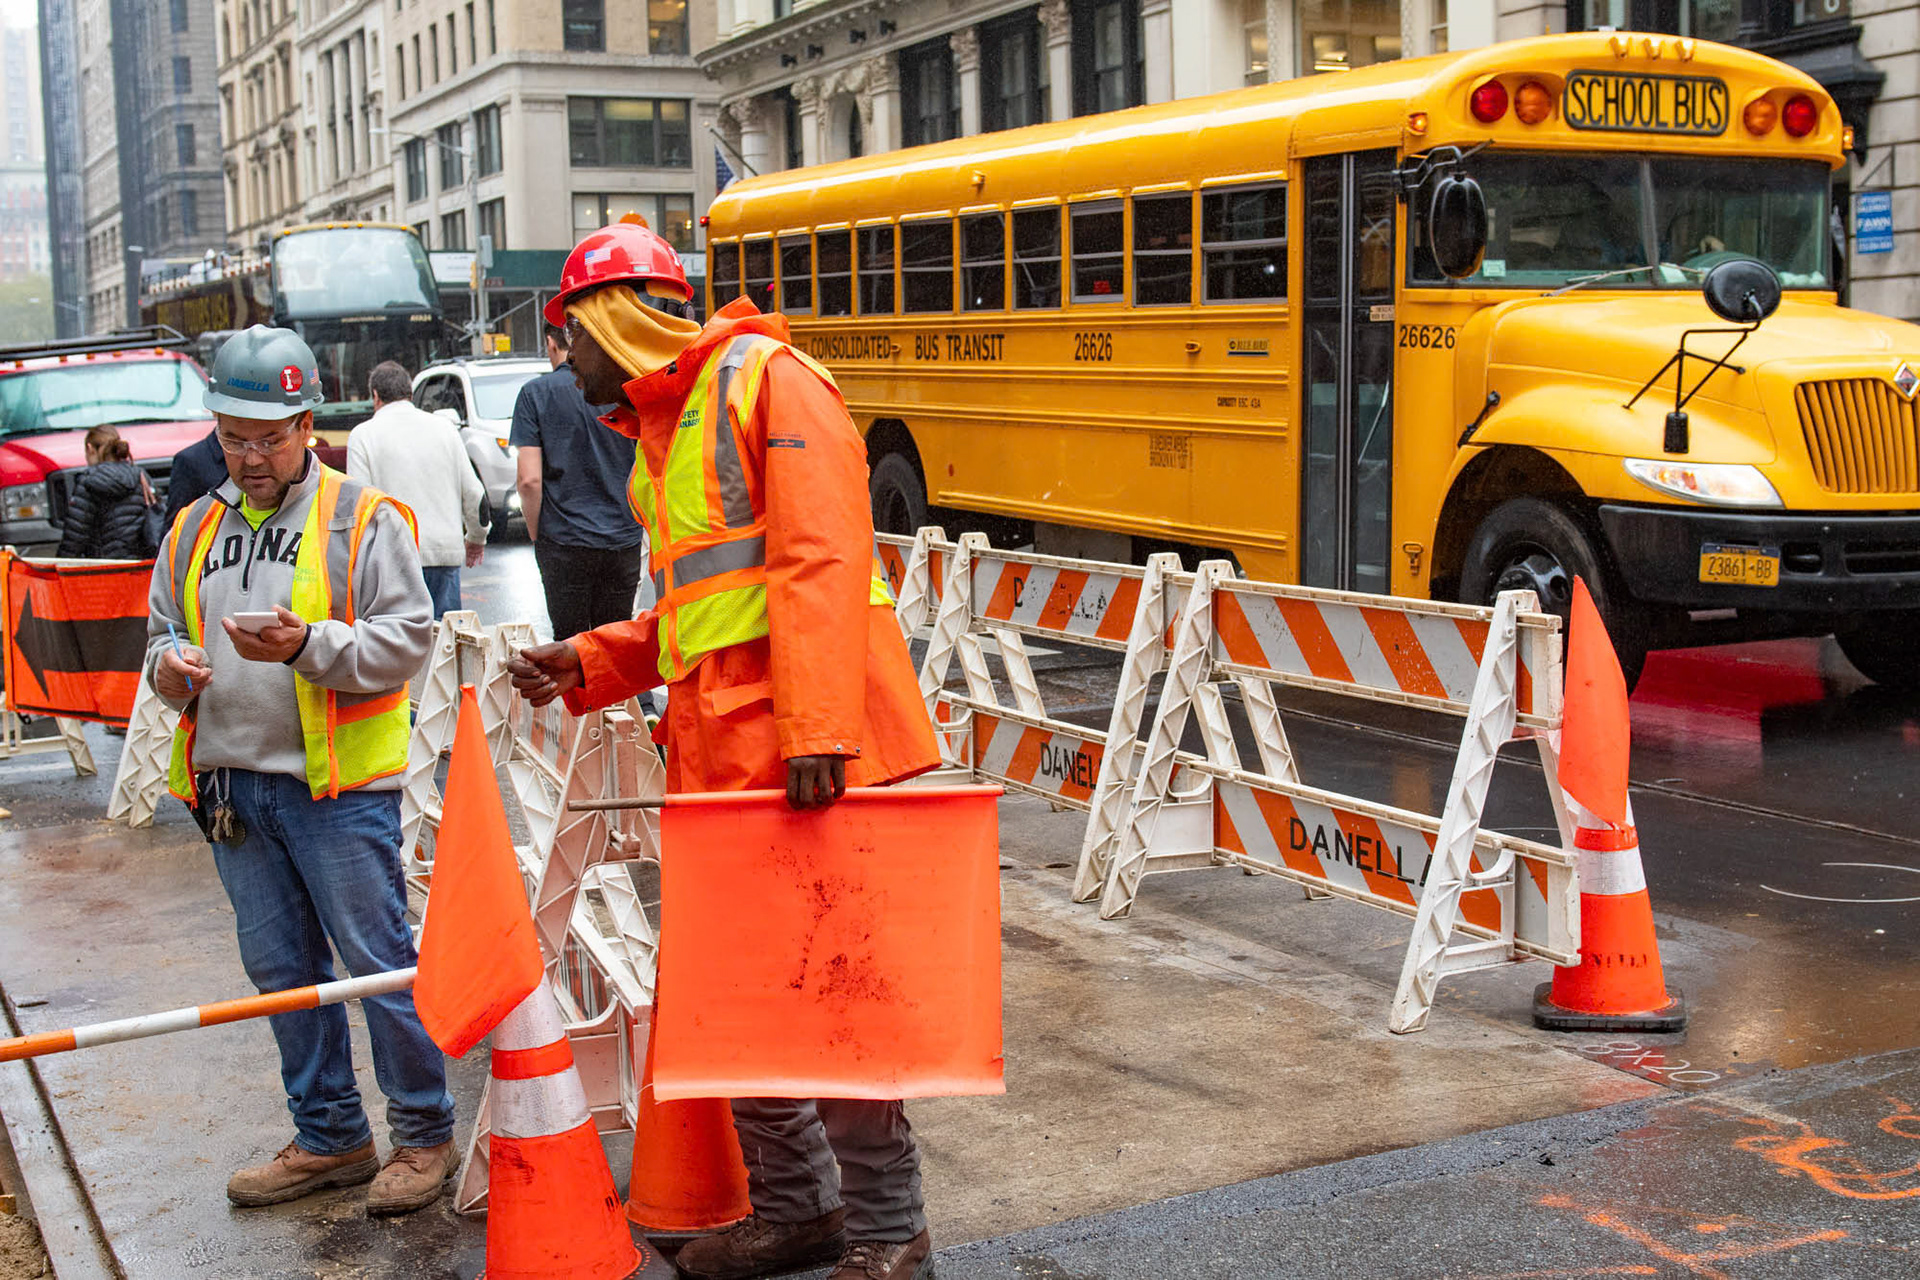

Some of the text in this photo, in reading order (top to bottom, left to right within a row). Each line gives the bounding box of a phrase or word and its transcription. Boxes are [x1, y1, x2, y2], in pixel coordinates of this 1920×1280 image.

[1571, 76, 1723, 130] SCHOOL BUS
[811, 333, 1005, 361] CONSOLIDATED BUS TRANSIT
[1074, 332, 1113, 362] 26626
[1399, 324, 1456, 349] 26626
[1040, 742, 1102, 790] DANEL
